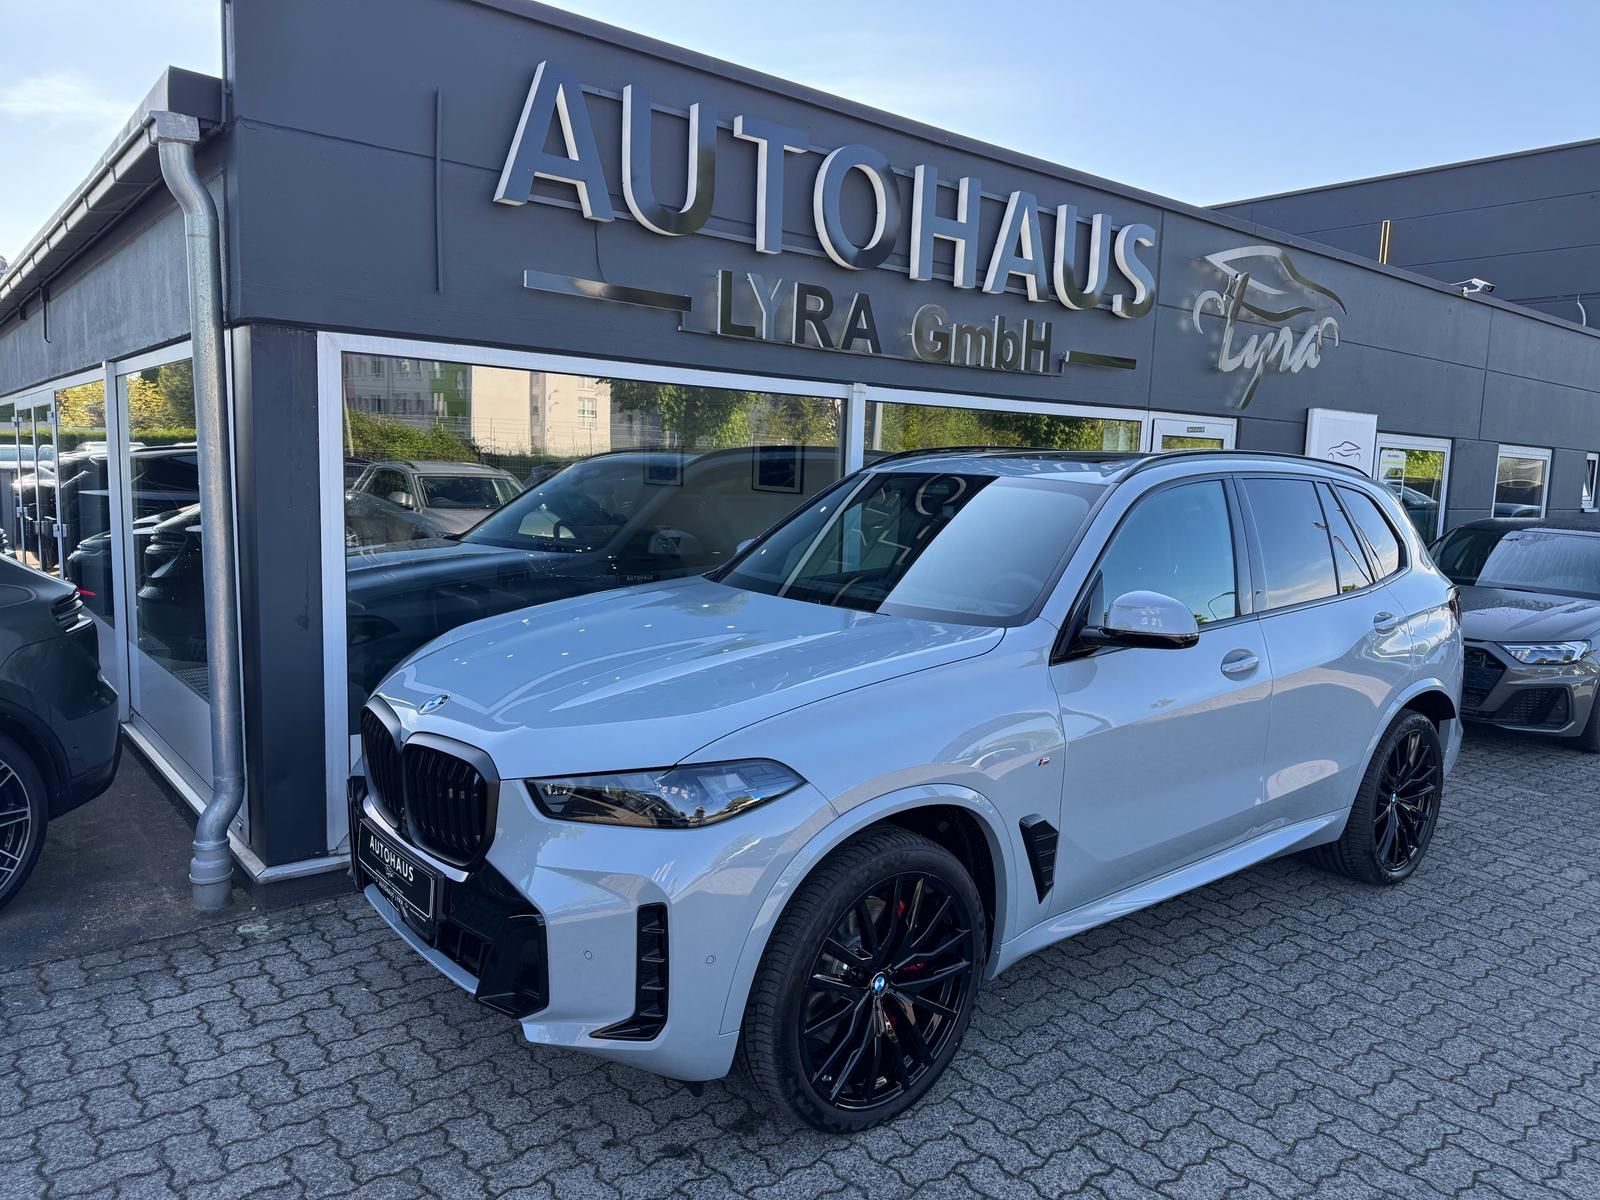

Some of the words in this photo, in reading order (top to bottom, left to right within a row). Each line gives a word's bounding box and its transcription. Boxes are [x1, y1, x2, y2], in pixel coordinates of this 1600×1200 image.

[493, 60, 1157, 320] AUTOHAUS
[717, 269, 882, 354] LYRA
[909, 303, 1053, 373] GmbH
[369, 834, 414, 882] AUTOHAUS
